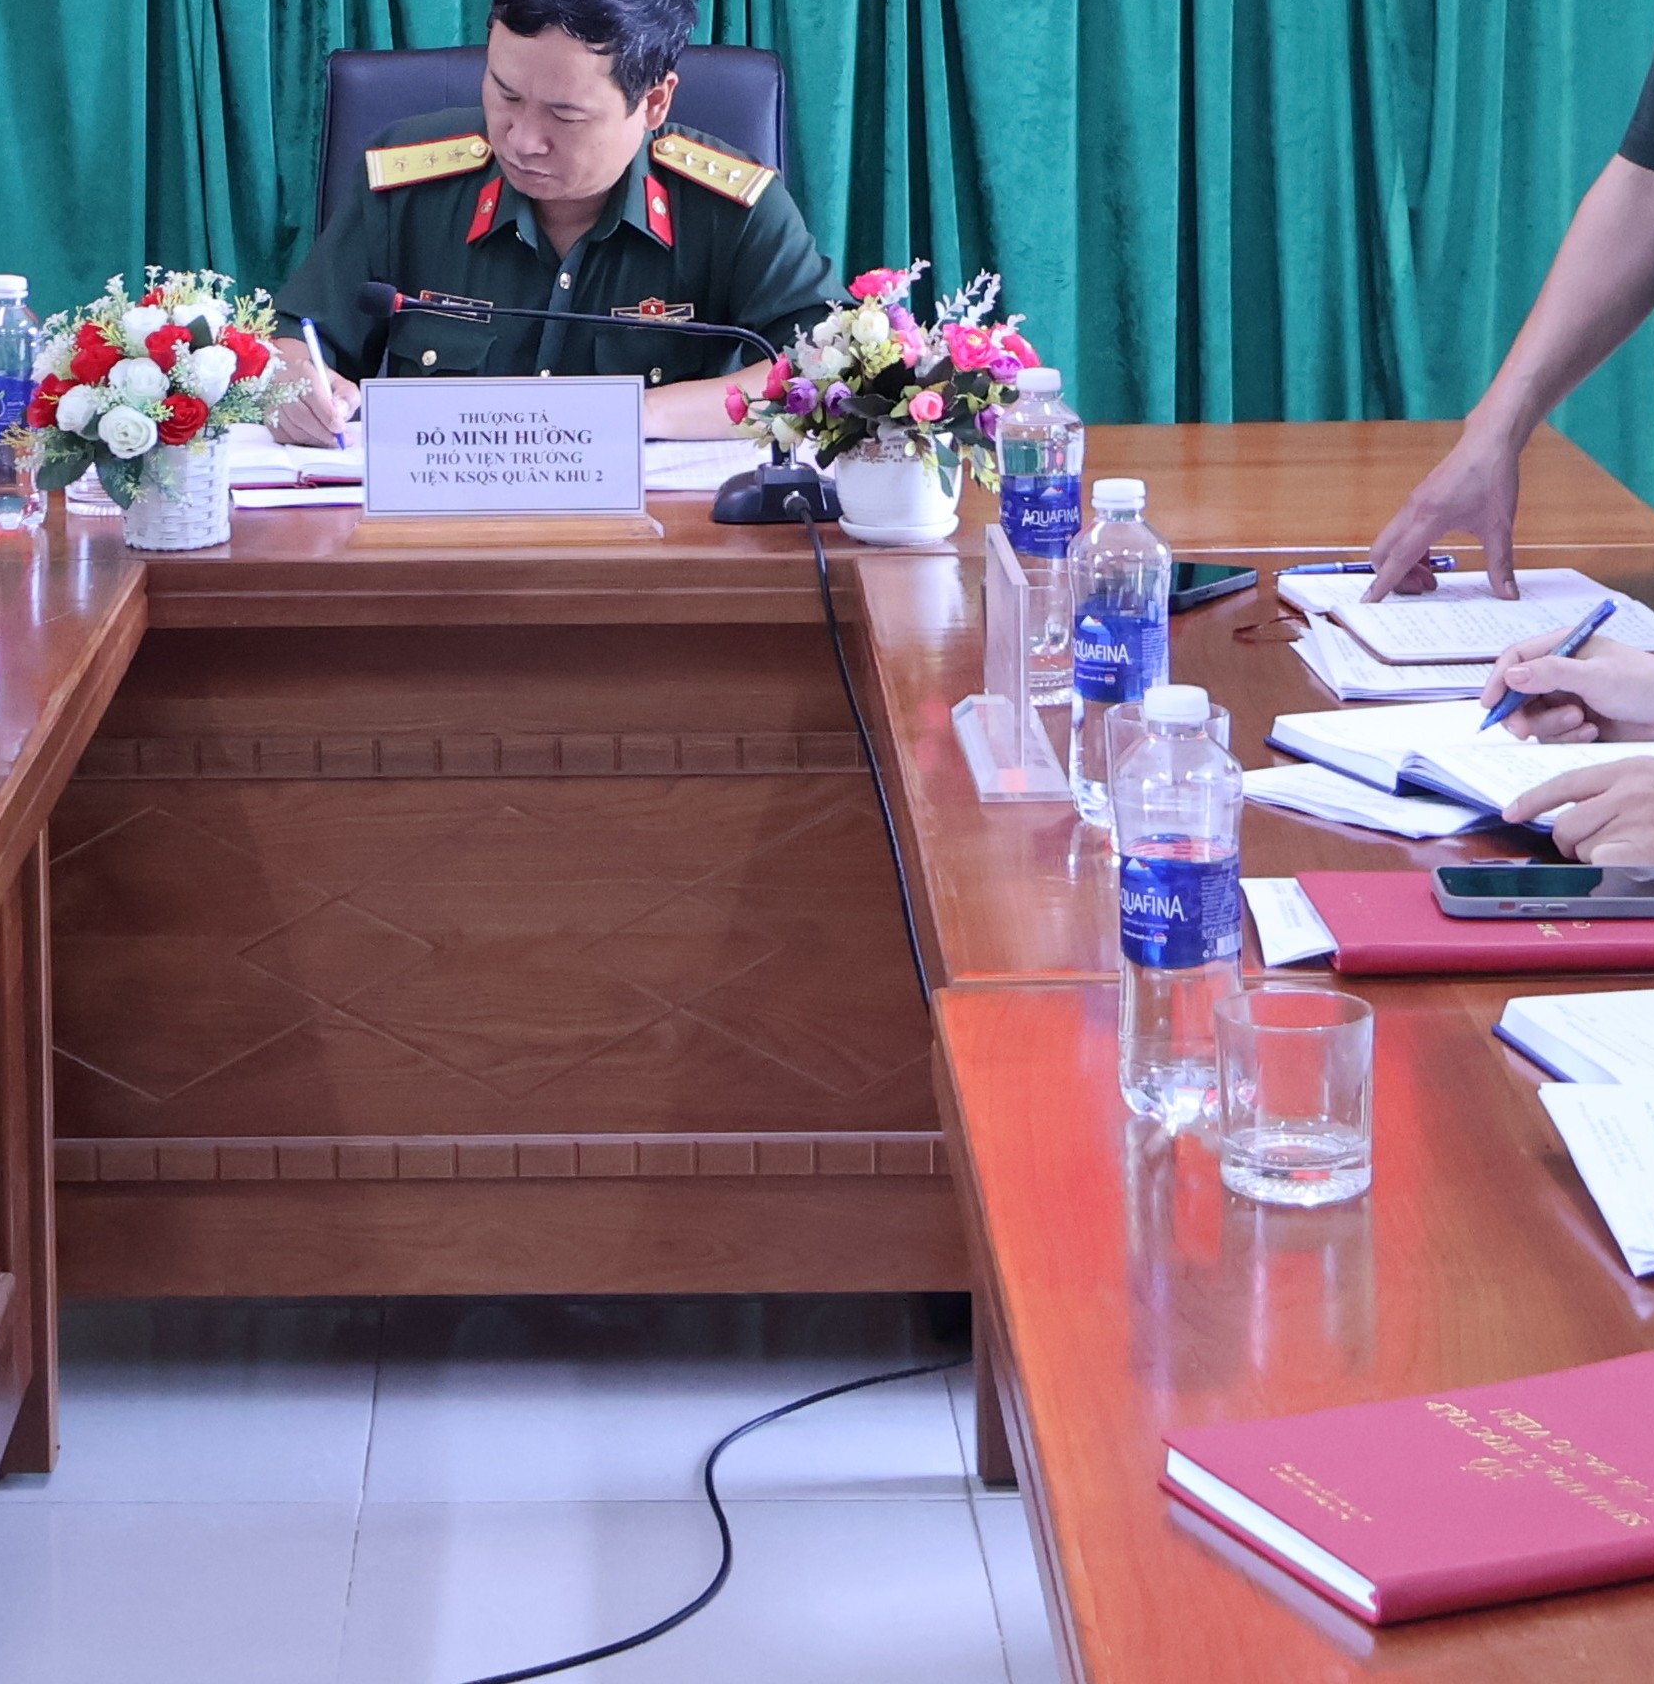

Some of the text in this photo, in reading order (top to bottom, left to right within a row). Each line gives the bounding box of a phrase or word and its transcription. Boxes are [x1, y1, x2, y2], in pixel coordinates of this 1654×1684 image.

[458, 411, 525, 426] THƯỢNG
[451, 430, 508, 445] MINH
[426, 449, 461, 465] PHÓ
[465, 450, 506, 467] VIỆN
[410, 467, 604, 486] VIỆN KSQS QUÂN KHU 2
[1022, 505, 1080, 527] AQUAFINA
[1074, 639, 1130, 665] QUAFINA
[1119, 887, 1186, 922] QUAFINA
